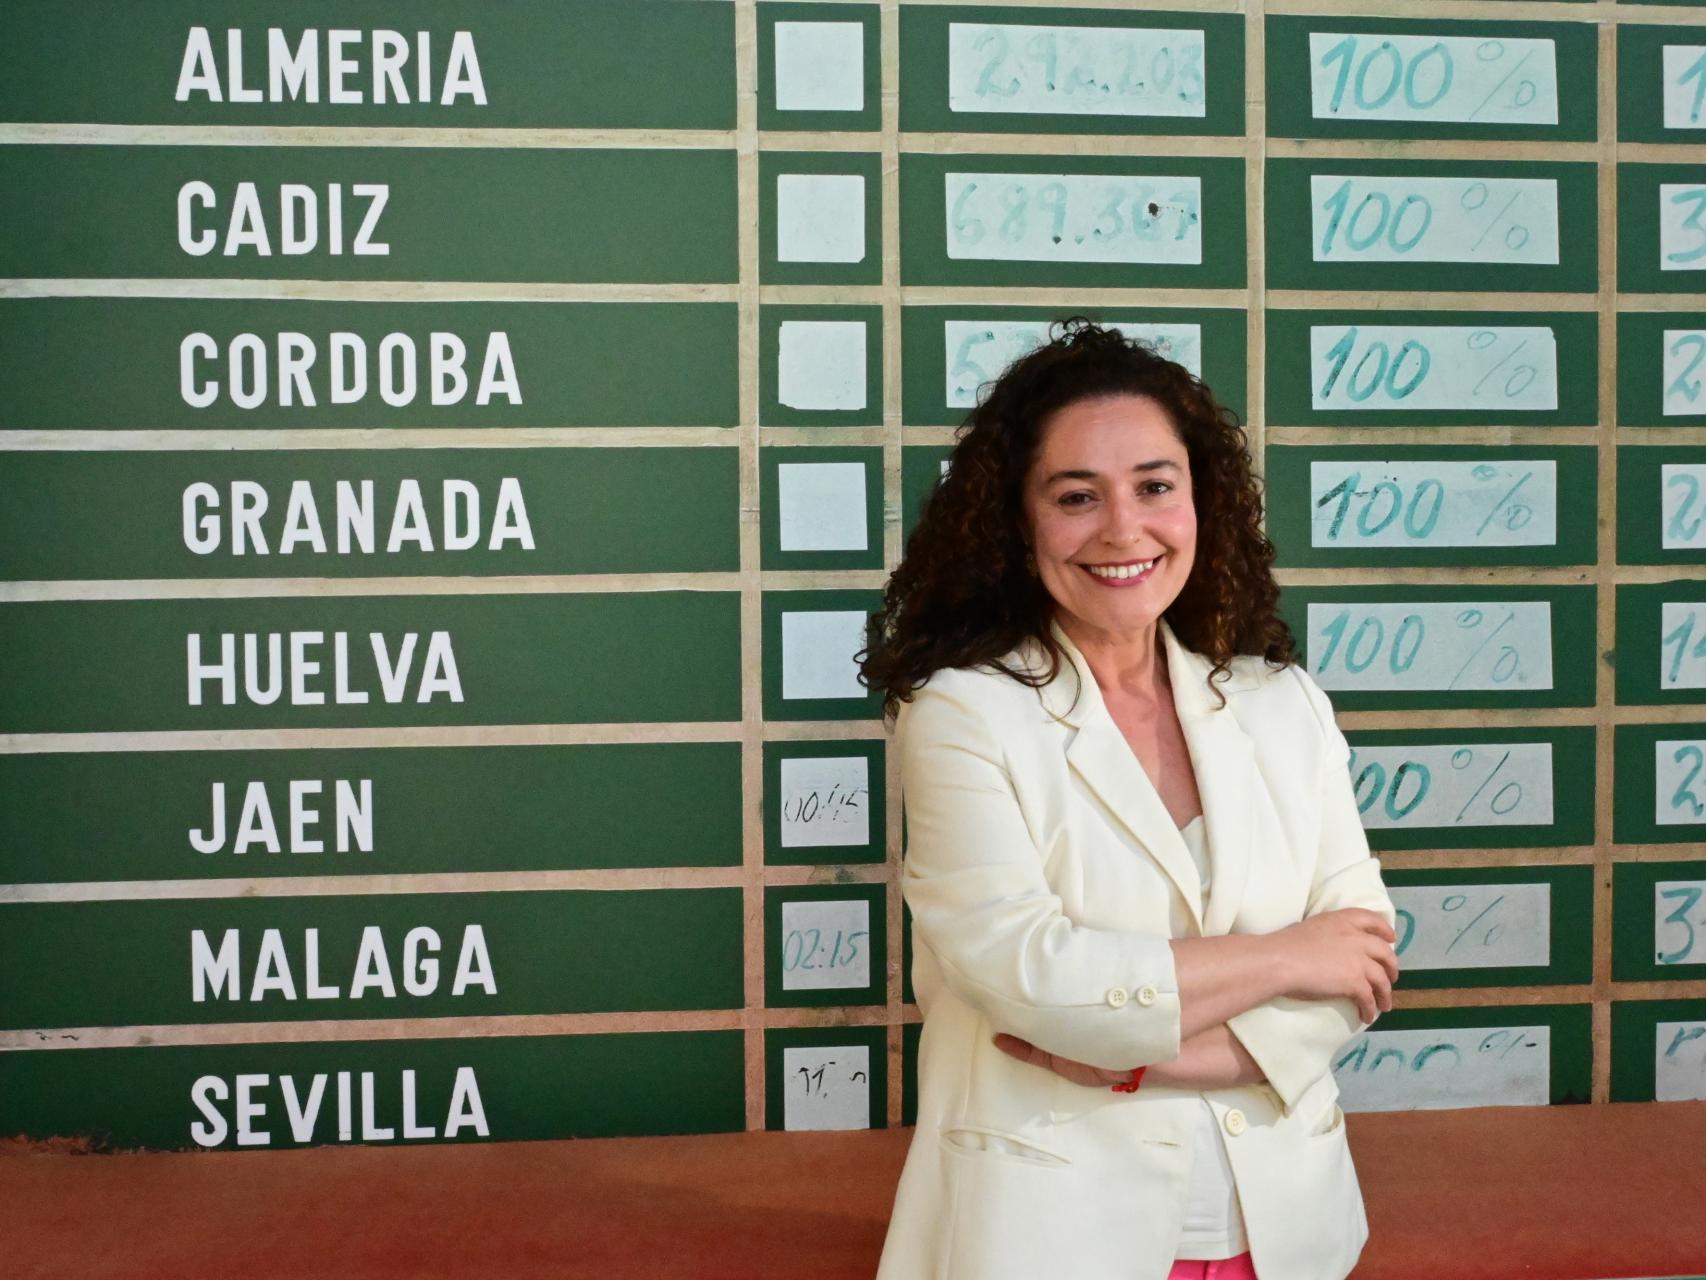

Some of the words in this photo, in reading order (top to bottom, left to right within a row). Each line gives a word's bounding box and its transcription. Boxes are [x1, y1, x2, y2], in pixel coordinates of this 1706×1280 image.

[176, 27, 487, 105] ALMERIA
[1321, 36, 1453, 113] 100
[1469, 41, 1536, 120] %
[178, 181, 389, 256] CADIZ
[1323, 180, 1432, 255] 100
[1461, 182, 1529, 251] %
[181, 332, 522, 409] CORDOBA
[1320, 327, 1430, 401] 100
[1467, 331, 1536, 397] %
[183, 478, 535, 555] GRANADA
[1317, 472, 1444, 540] 100
[1472, 465, 1533, 536] %
[1667, 473, 1706, 541] 2
[188, 632, 464, 705] HUELVA
[1317, 609, 1424, 675] 100
[1448, 608, 1520, 691] %
[190, 780, 372, 853] JAEN
[1451, 748, 1523, 823] %
[1671, 745, 1706, 816] 2
[192, 925, 496, 1001] MALAGA
[783, 928, 869, 972] 02:15
[1657, 887, 1706, 964] 3
[192, 1067, 489, 1146] SEVILLA
